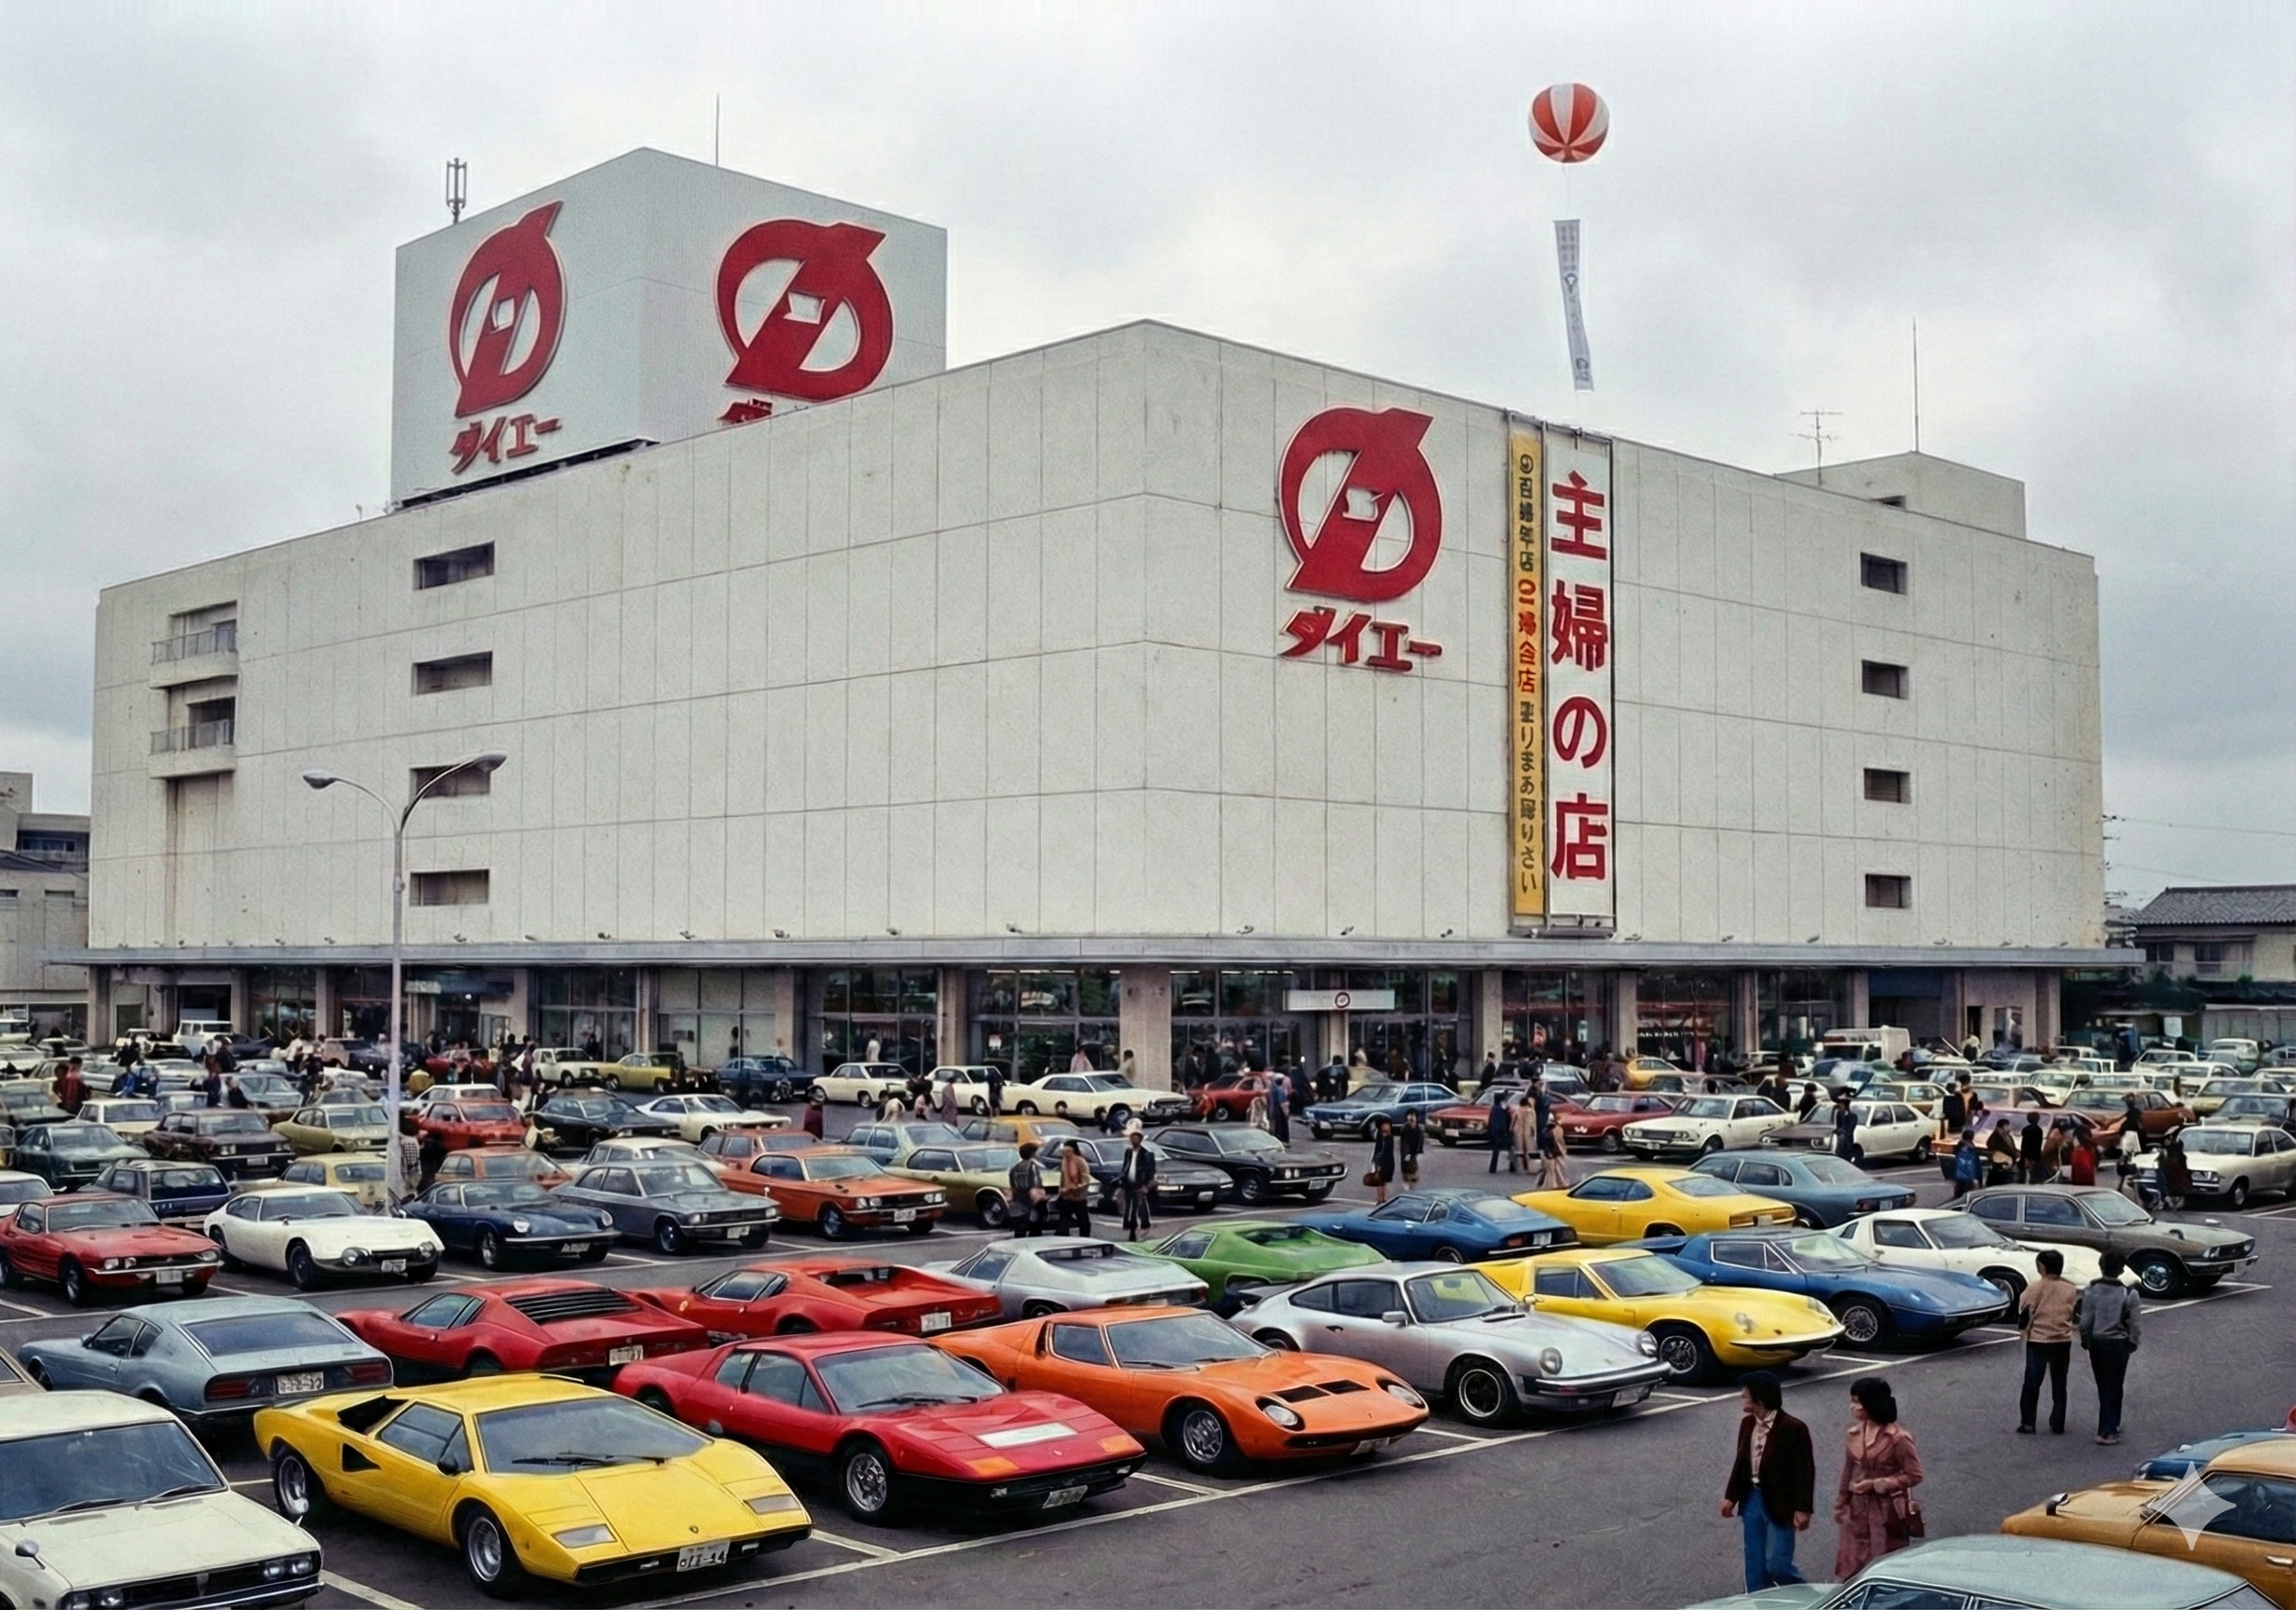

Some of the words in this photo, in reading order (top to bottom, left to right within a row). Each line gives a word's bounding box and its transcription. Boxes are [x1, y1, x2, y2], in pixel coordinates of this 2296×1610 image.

[449, 414, 562, 475] ダイエー
[1278, 605, 1442, 672] ダイエー
[1551, 470, 1608, 880] 主婦の店
